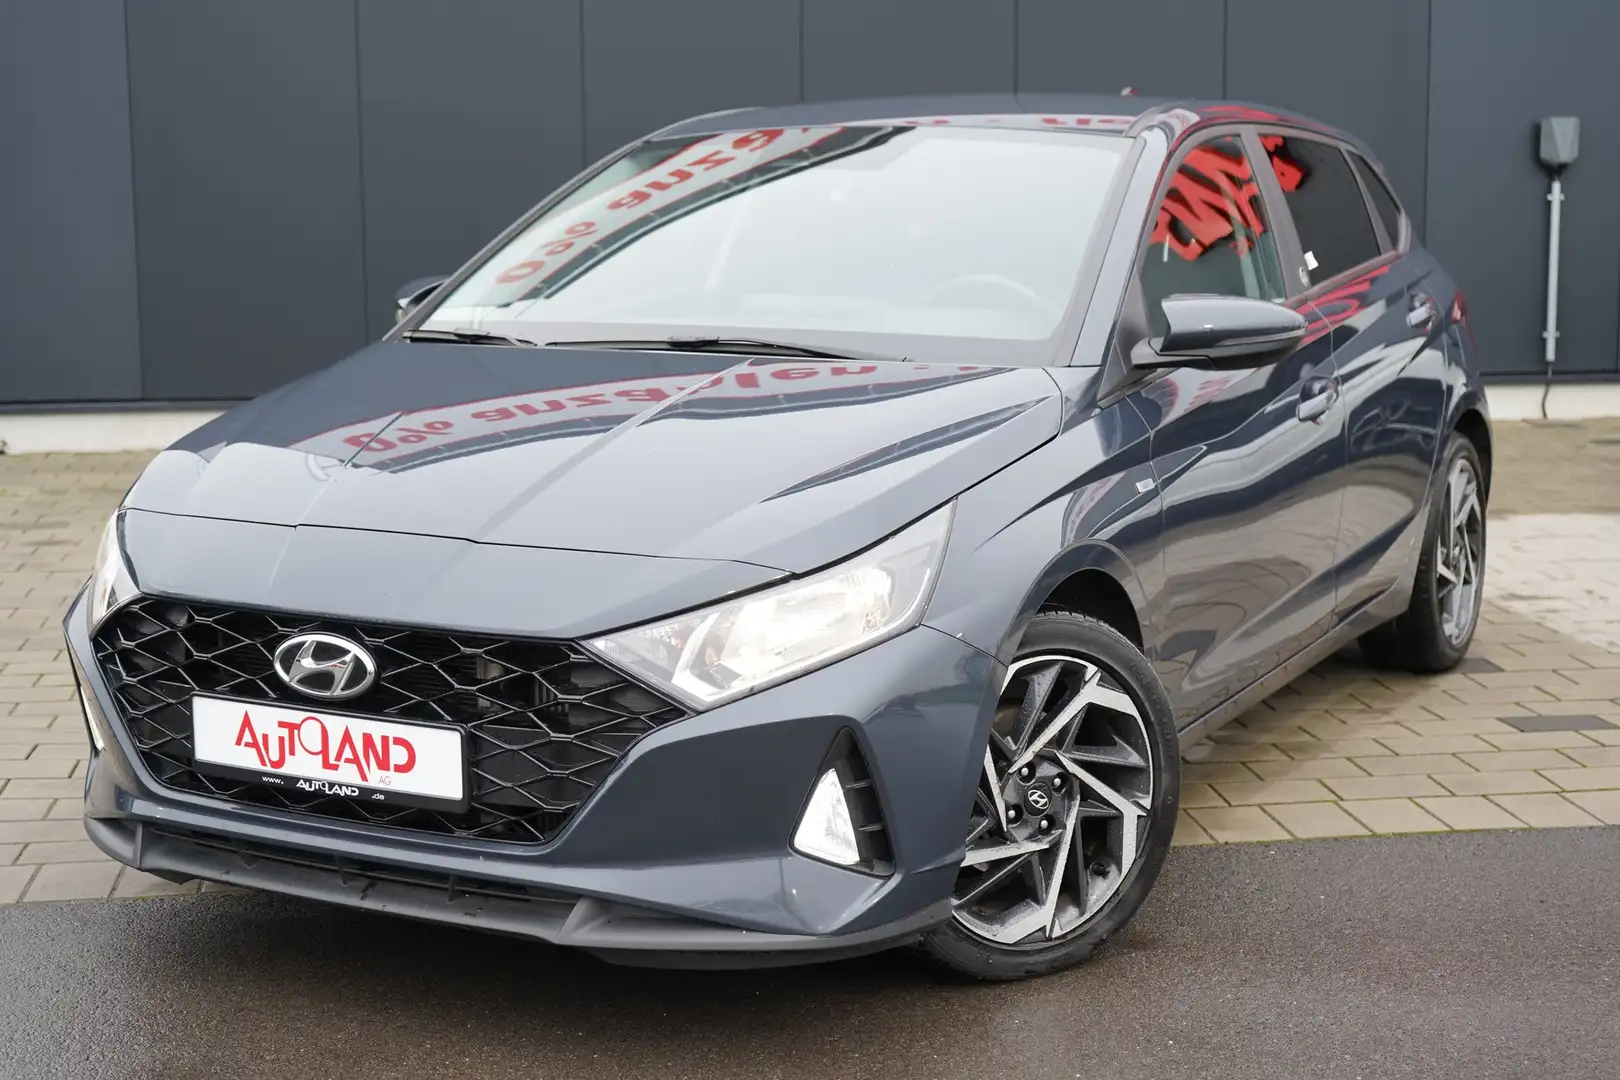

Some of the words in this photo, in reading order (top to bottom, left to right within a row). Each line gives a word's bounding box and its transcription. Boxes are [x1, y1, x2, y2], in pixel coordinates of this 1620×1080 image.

[261, 775, 285, 785] www.
[371, 792, 386, 801] .de
[378, 775, 392, 786] AG
